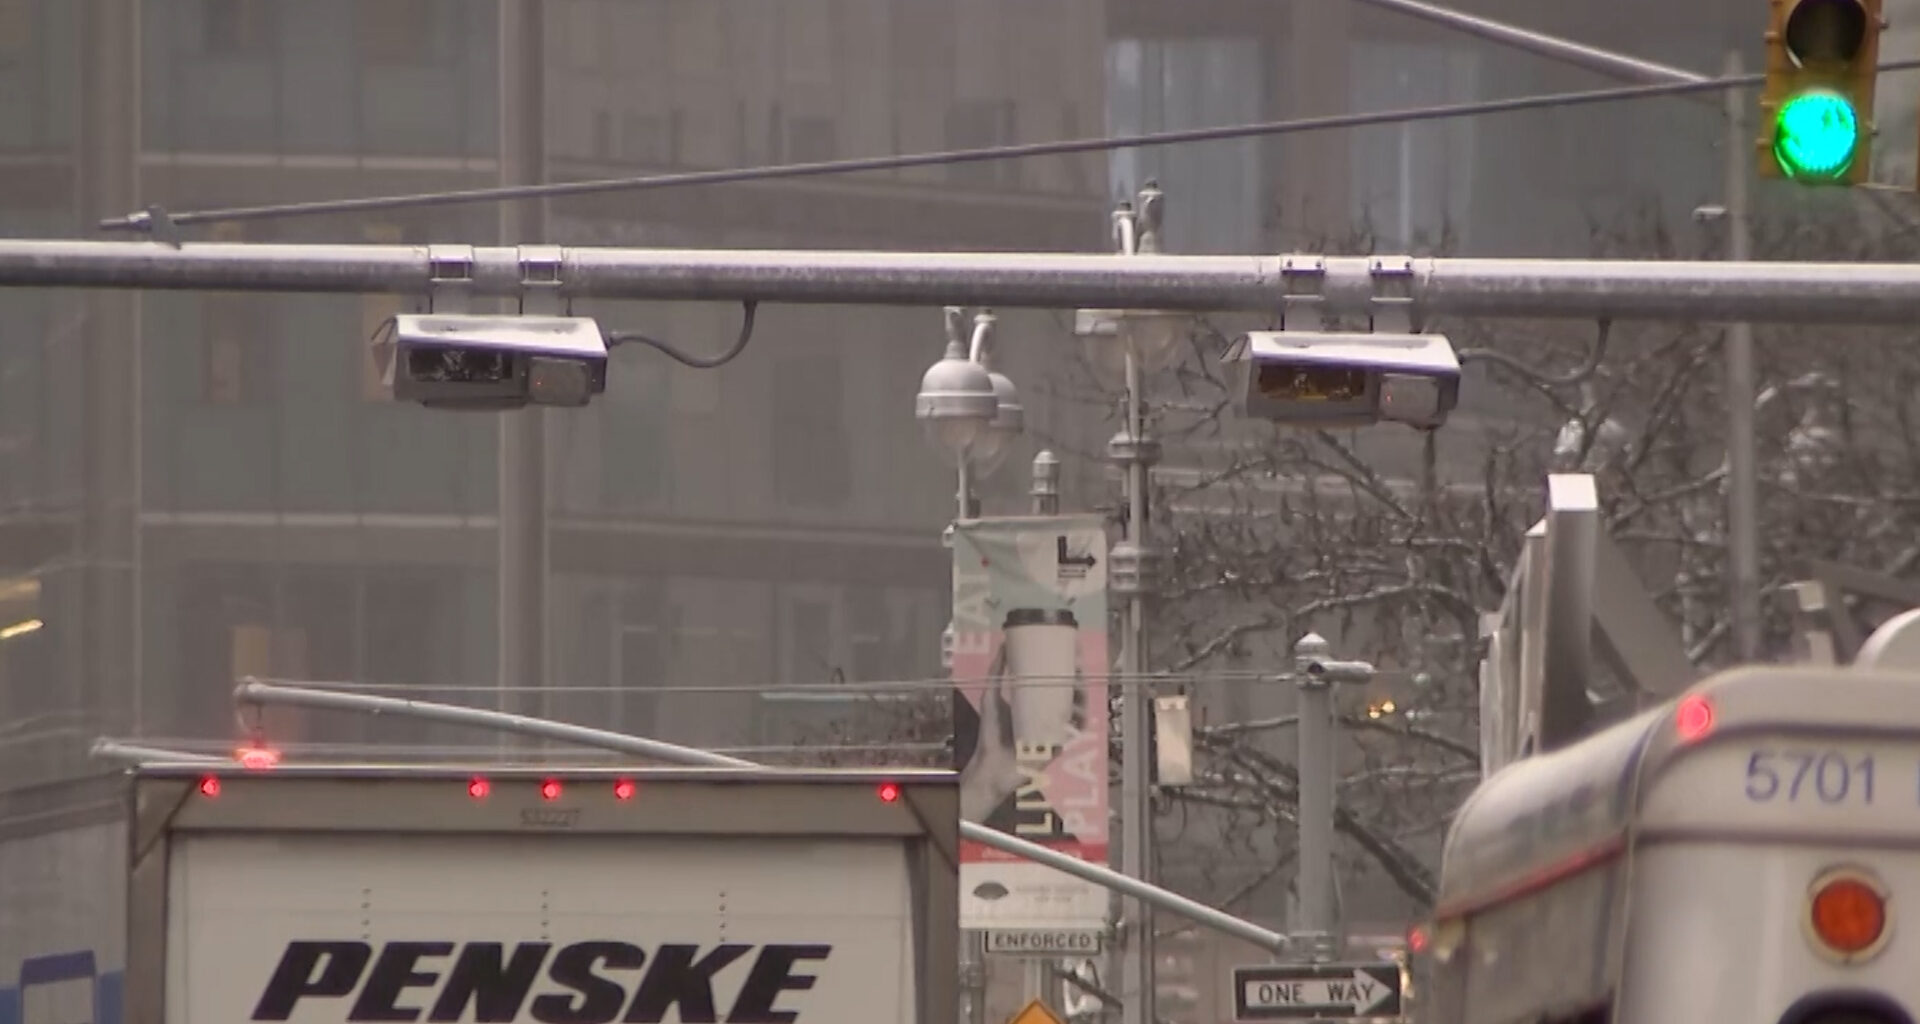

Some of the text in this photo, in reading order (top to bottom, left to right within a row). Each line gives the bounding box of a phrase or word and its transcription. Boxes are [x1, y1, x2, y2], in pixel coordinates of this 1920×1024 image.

[1015, 740, 1052, 834] LIVE
[1745, 750, 1873, 803] 5701
[995, 932, 1091, 948] ENFORCED
[250, 940, 832, 1024] PENSKE
[1258, 982, 1375, 1004] ONE WAY
